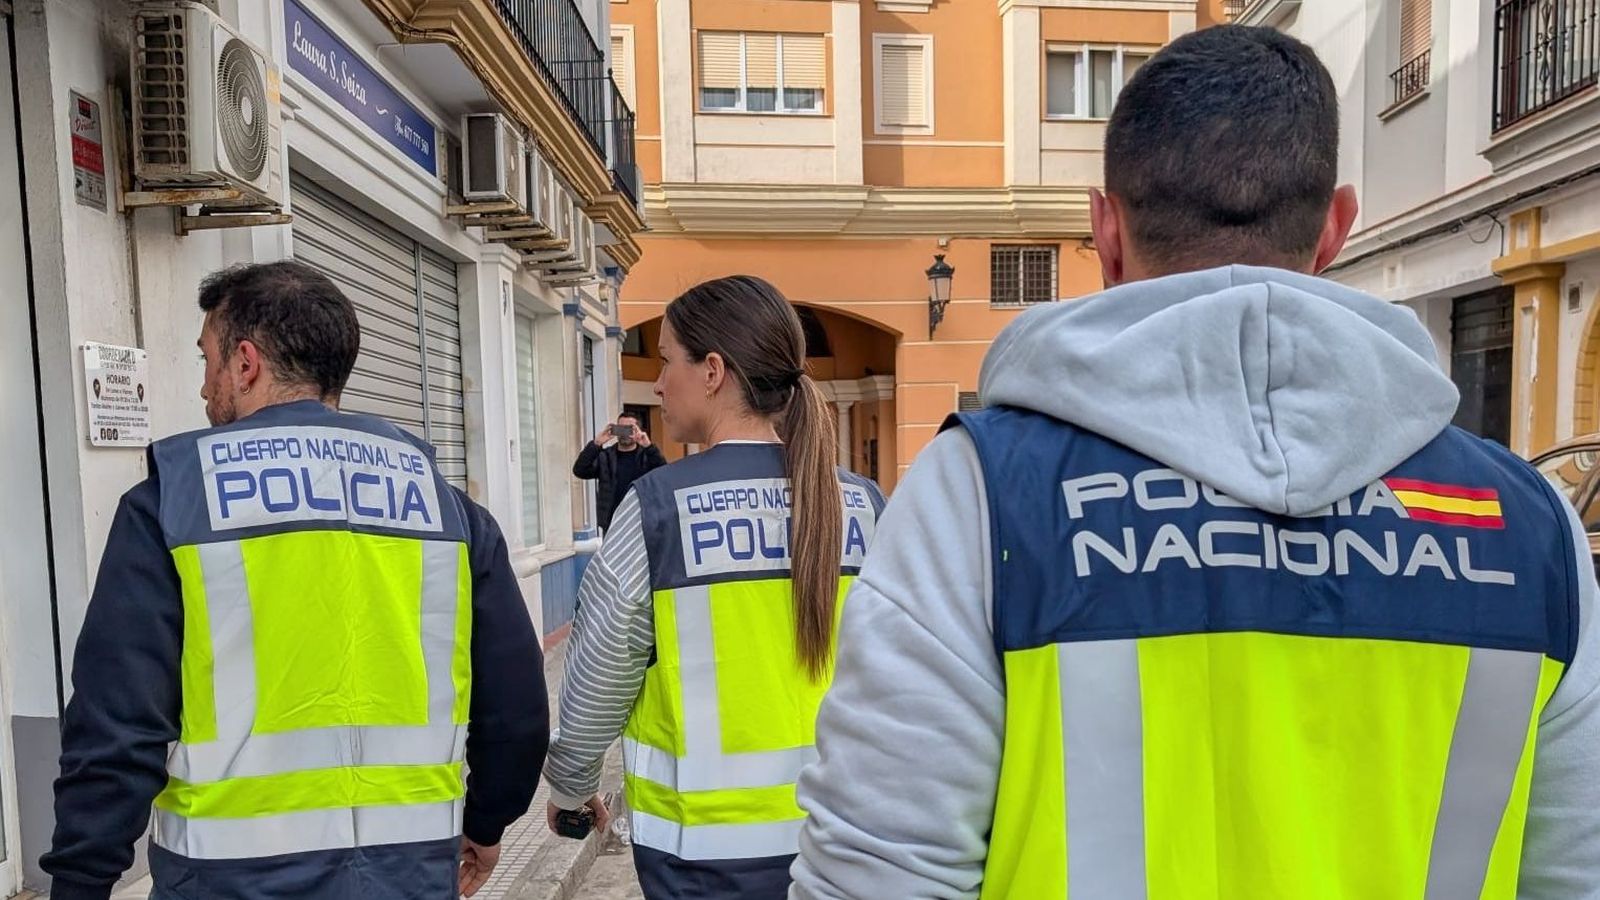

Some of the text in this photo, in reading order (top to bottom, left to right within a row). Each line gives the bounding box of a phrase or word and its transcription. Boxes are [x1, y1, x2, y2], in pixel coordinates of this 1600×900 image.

[293, 20, 367, 106] Laura S. Soiza
[211, 437, 425, 476] CUERPO NACIONAL DE
[215, 467, 432, 524] POLICIA
[687, 487, 759, 514] CUERPO
[843, 490, 866, 509] DE
[1062, 468, 1410, 519] POLA
[690, 516, 866, 565] POLIA
[1072, 520, 1515, 586] NACIONAL
